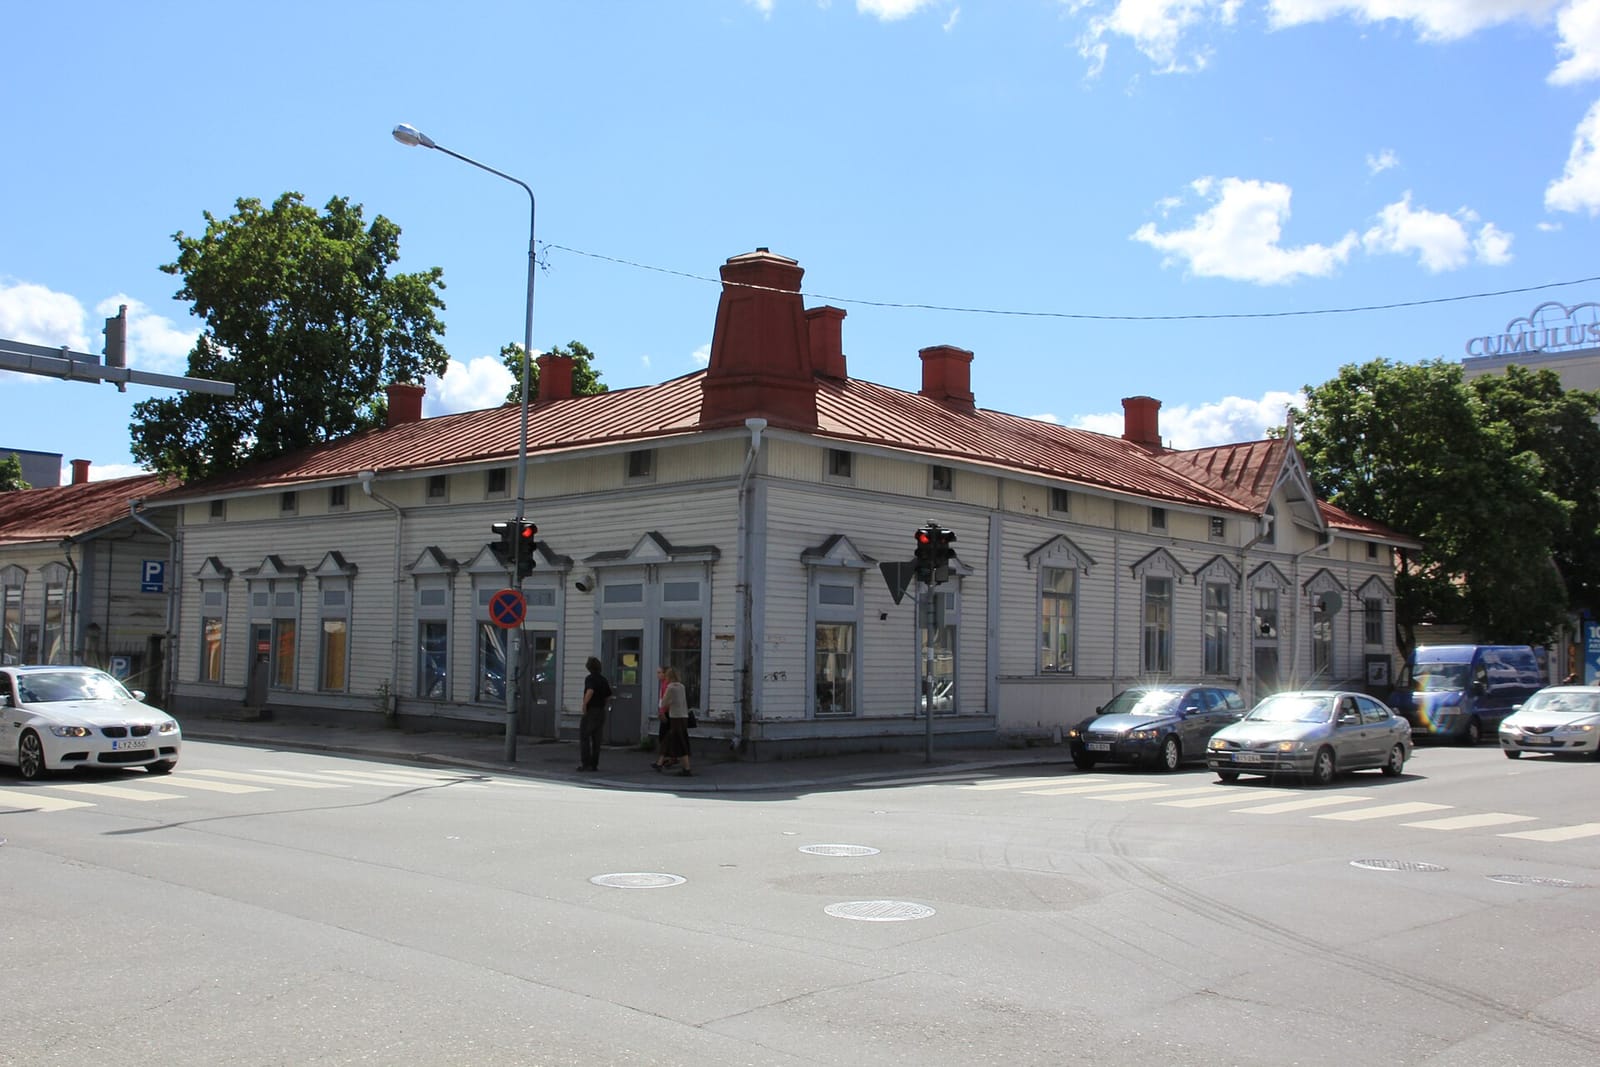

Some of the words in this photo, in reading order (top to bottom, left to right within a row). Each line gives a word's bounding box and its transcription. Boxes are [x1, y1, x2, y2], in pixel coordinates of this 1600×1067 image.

[1465, 322, 1600, 356] CUMULUS
[146, 562, 161, 582] P
[112, 659, 127, 677] P
